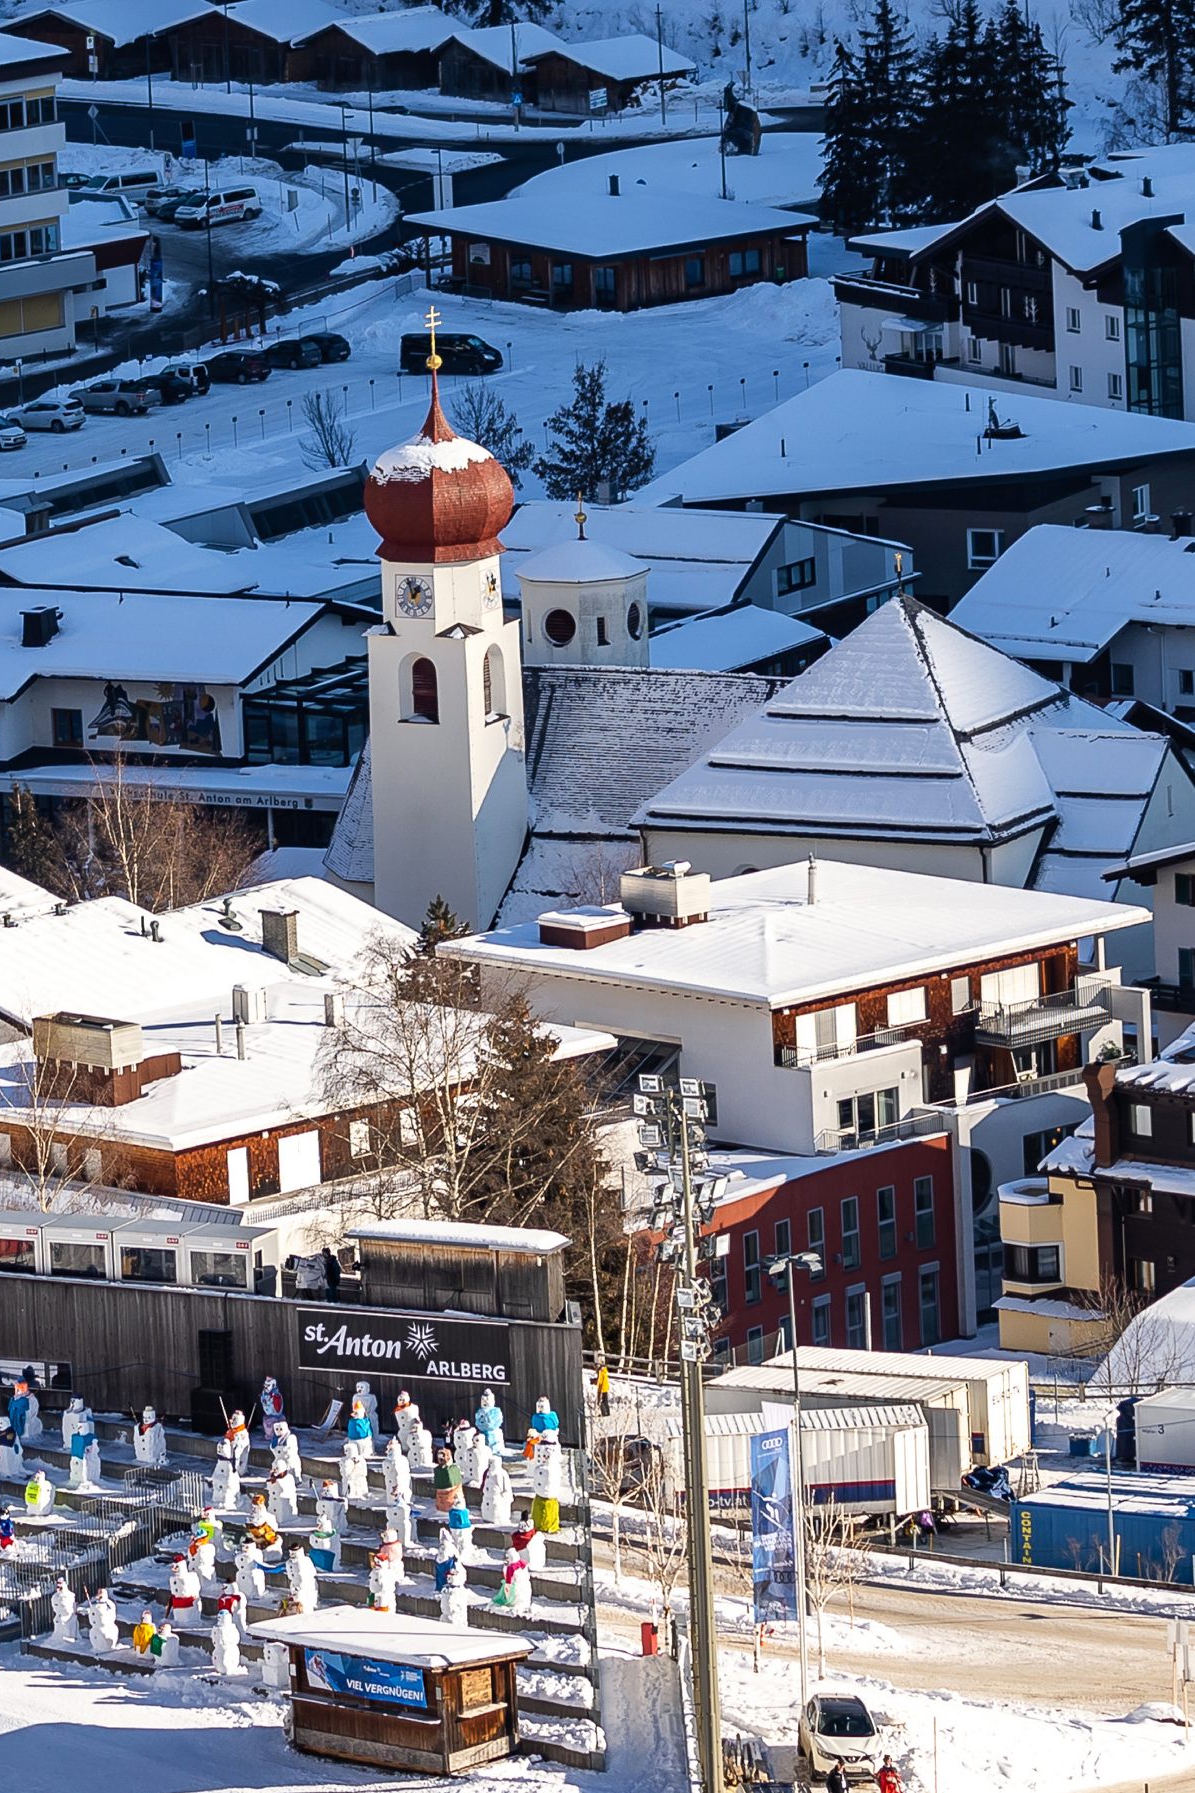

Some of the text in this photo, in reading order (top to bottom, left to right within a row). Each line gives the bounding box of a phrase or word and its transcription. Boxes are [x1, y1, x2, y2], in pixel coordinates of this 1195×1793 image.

[179, 791, 194, 801] St.
[199, 792, 230, 804] Anton
[236, 796, 252, 805] am
[257, 795, 299, 809] Arlberg
[426, 1360, 506, 1380] ARLBERG
[1157, 1424, 1165, 1435] 3
[346, 1678, 425, 1701] VIEL VERGNÜGEN!
